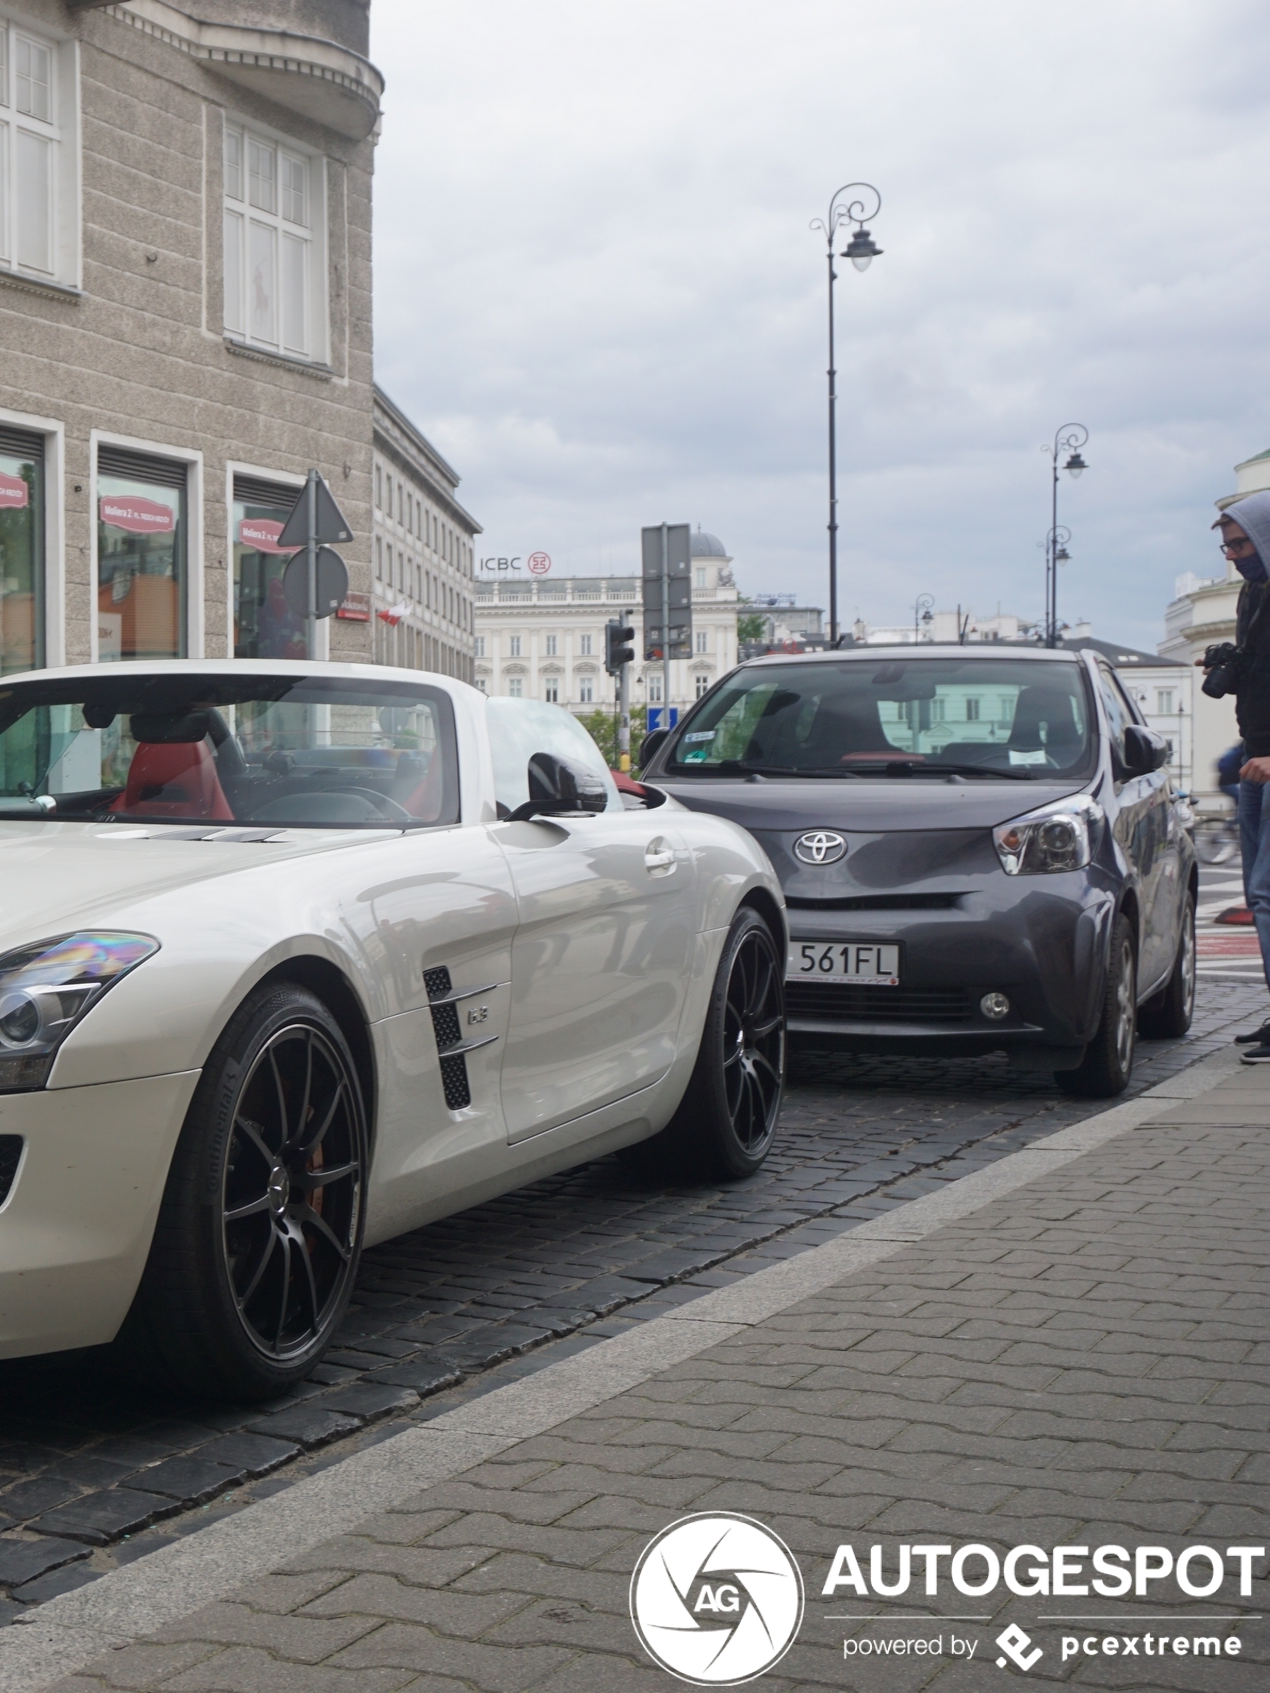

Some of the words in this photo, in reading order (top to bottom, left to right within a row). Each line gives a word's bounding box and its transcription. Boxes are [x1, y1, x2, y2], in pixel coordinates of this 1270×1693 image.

[104, 505, 127, 517] Moliera
[480, 557, 521, 571] ICBC
[800, 945, 892, 975] 561FL
[207, 1084, 235, 1195] Continental
